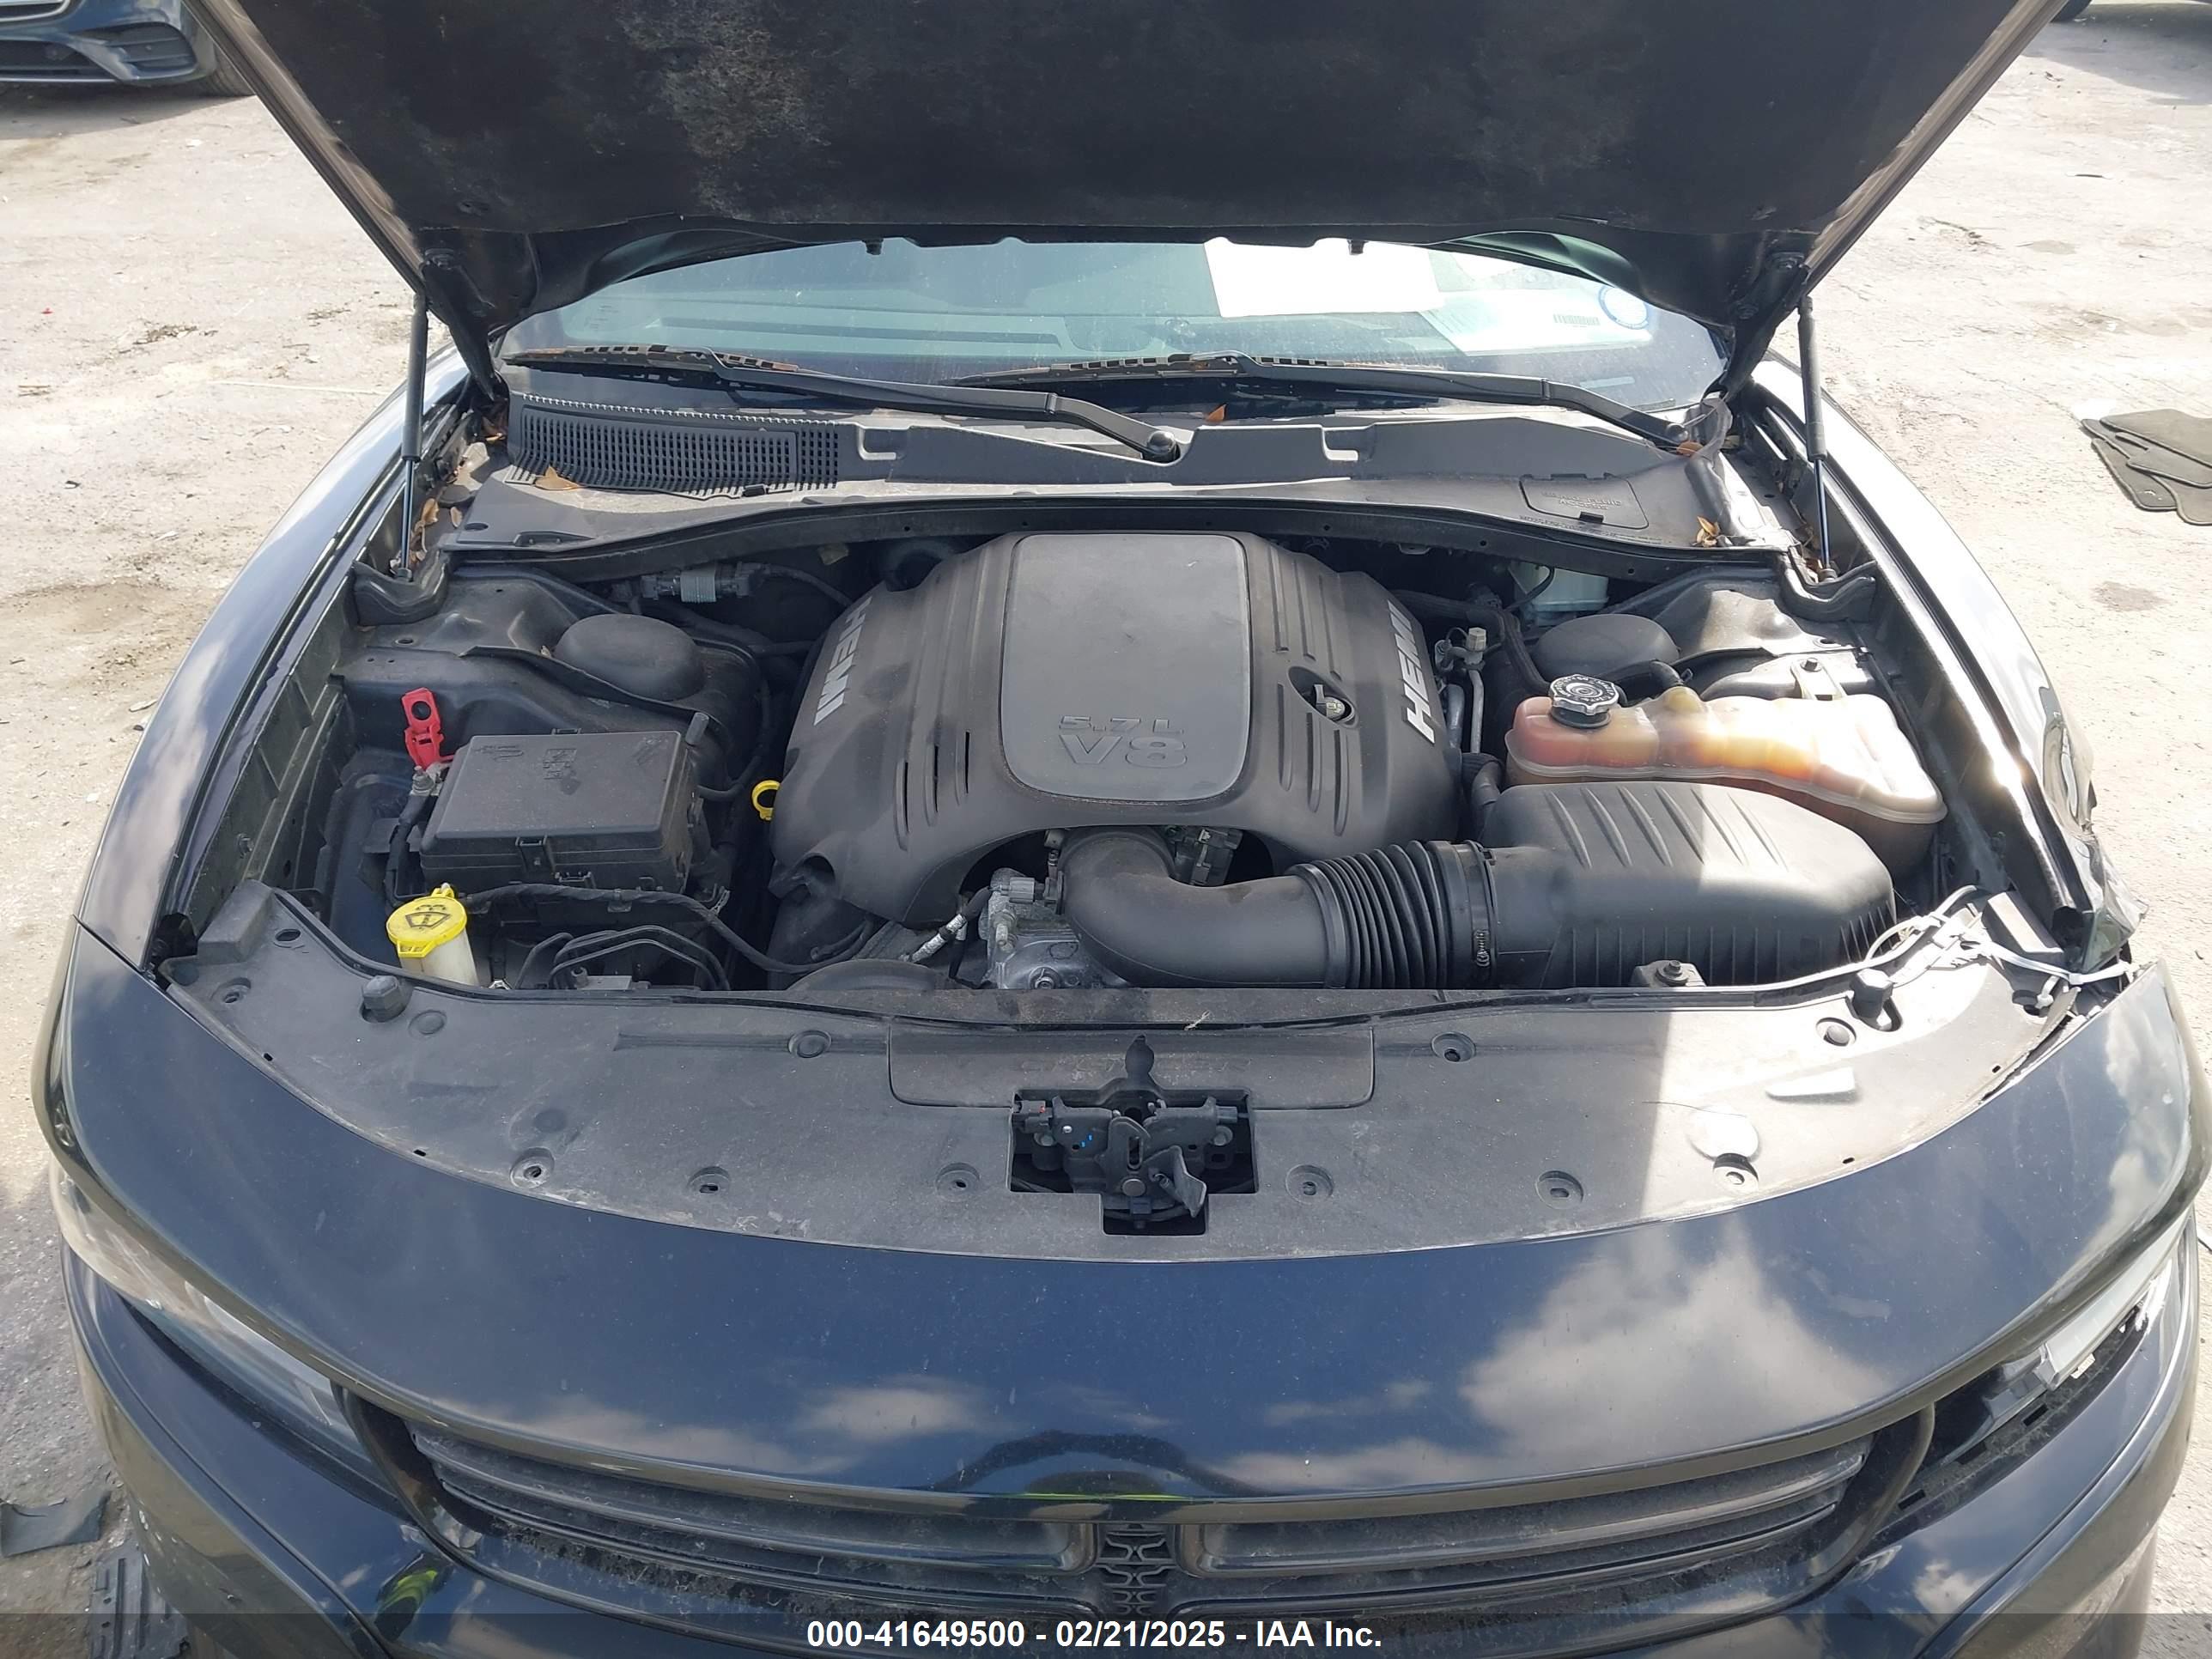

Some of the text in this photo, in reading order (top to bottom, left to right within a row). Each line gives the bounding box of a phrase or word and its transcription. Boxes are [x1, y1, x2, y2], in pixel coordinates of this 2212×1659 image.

[813, 596, 872, 726] HEMI
[1387, 599, 1436, 744] HEMI
[1058, 734, 1188, 769] V8
